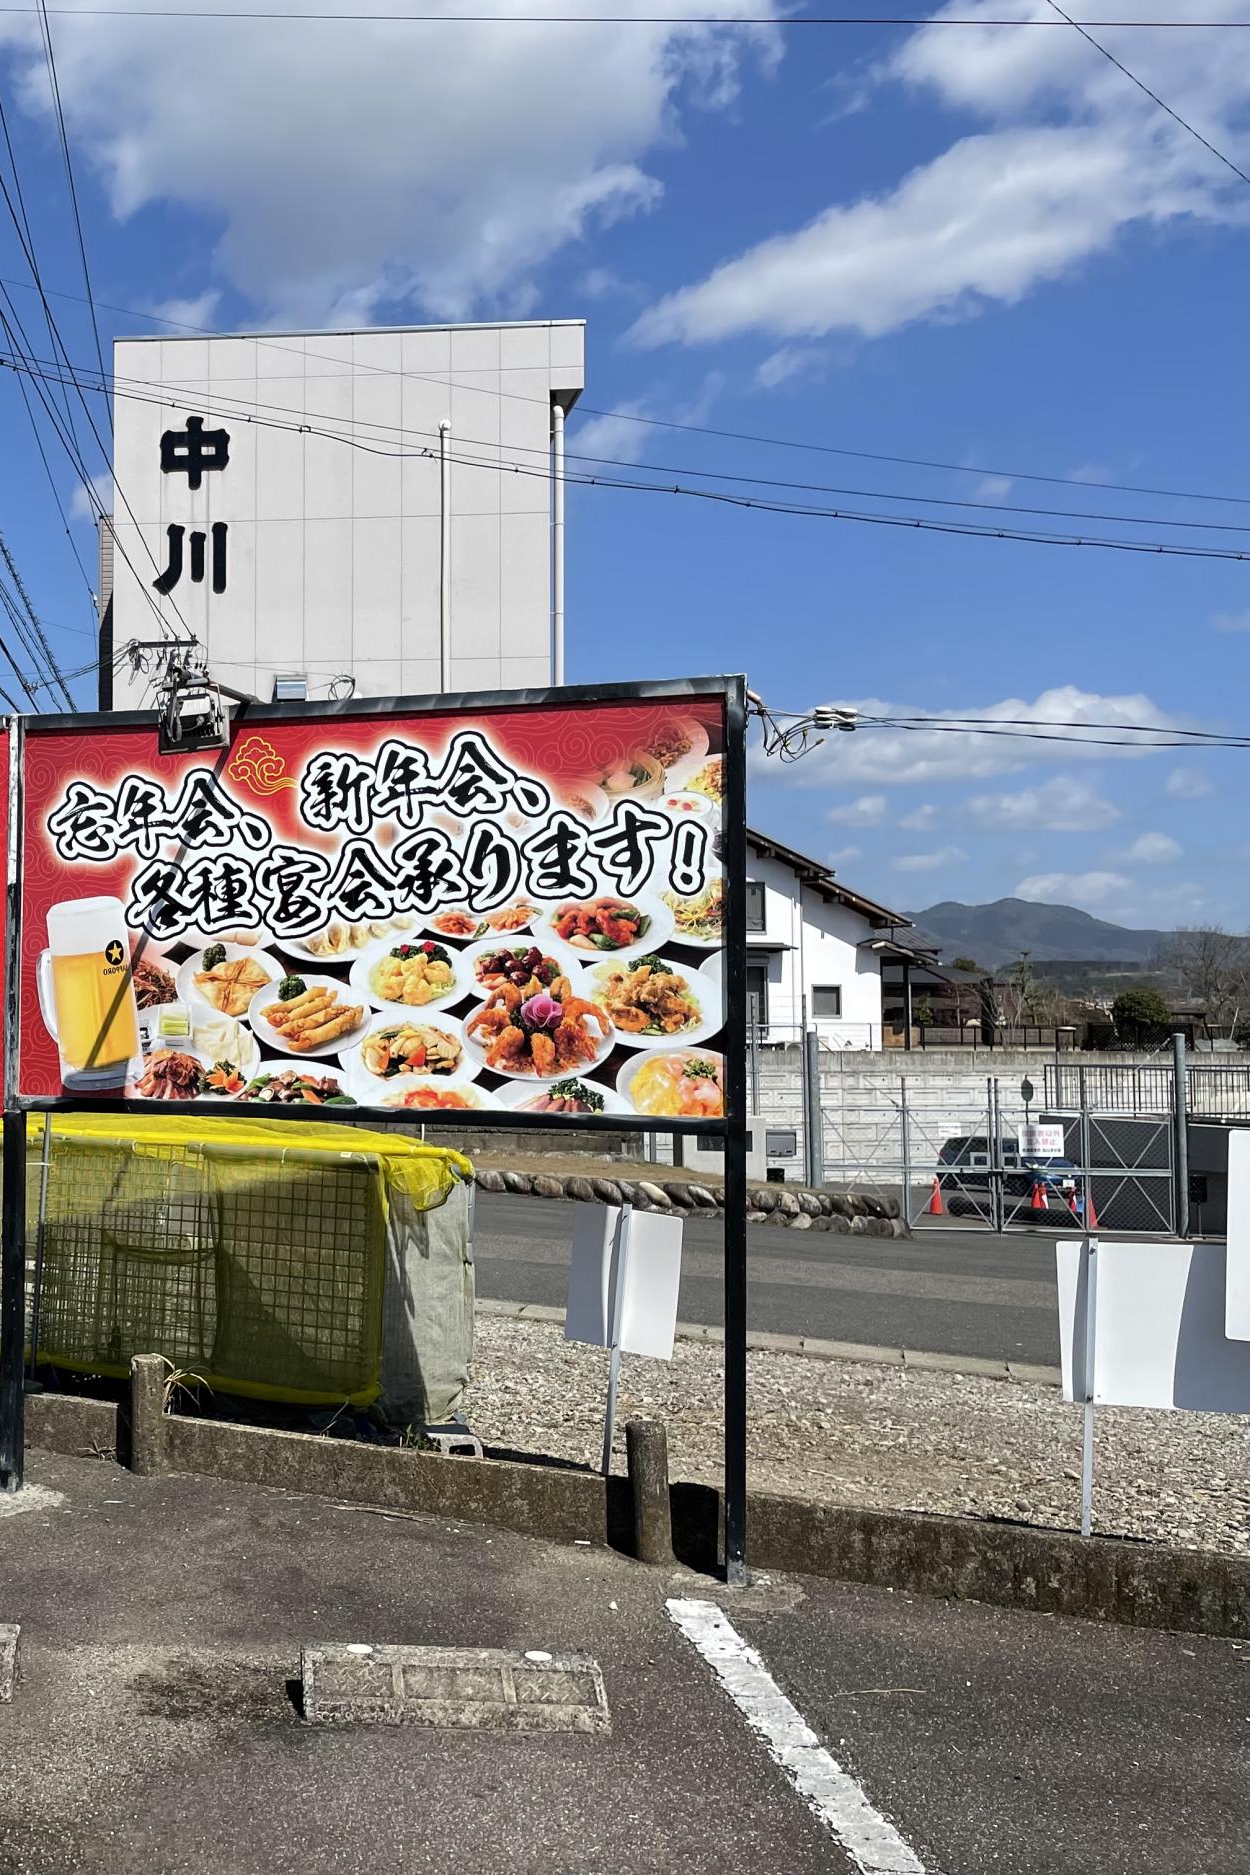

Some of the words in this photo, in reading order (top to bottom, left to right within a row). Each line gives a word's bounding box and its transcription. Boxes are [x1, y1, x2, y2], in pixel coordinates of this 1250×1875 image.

[152, 416, 230, 595] 中川
[57, 775, 266, 854] 忘年会、
[310, 739, 544, 829] 新年会、
[135, 807, 700, 935] 各種宴会承ります!
